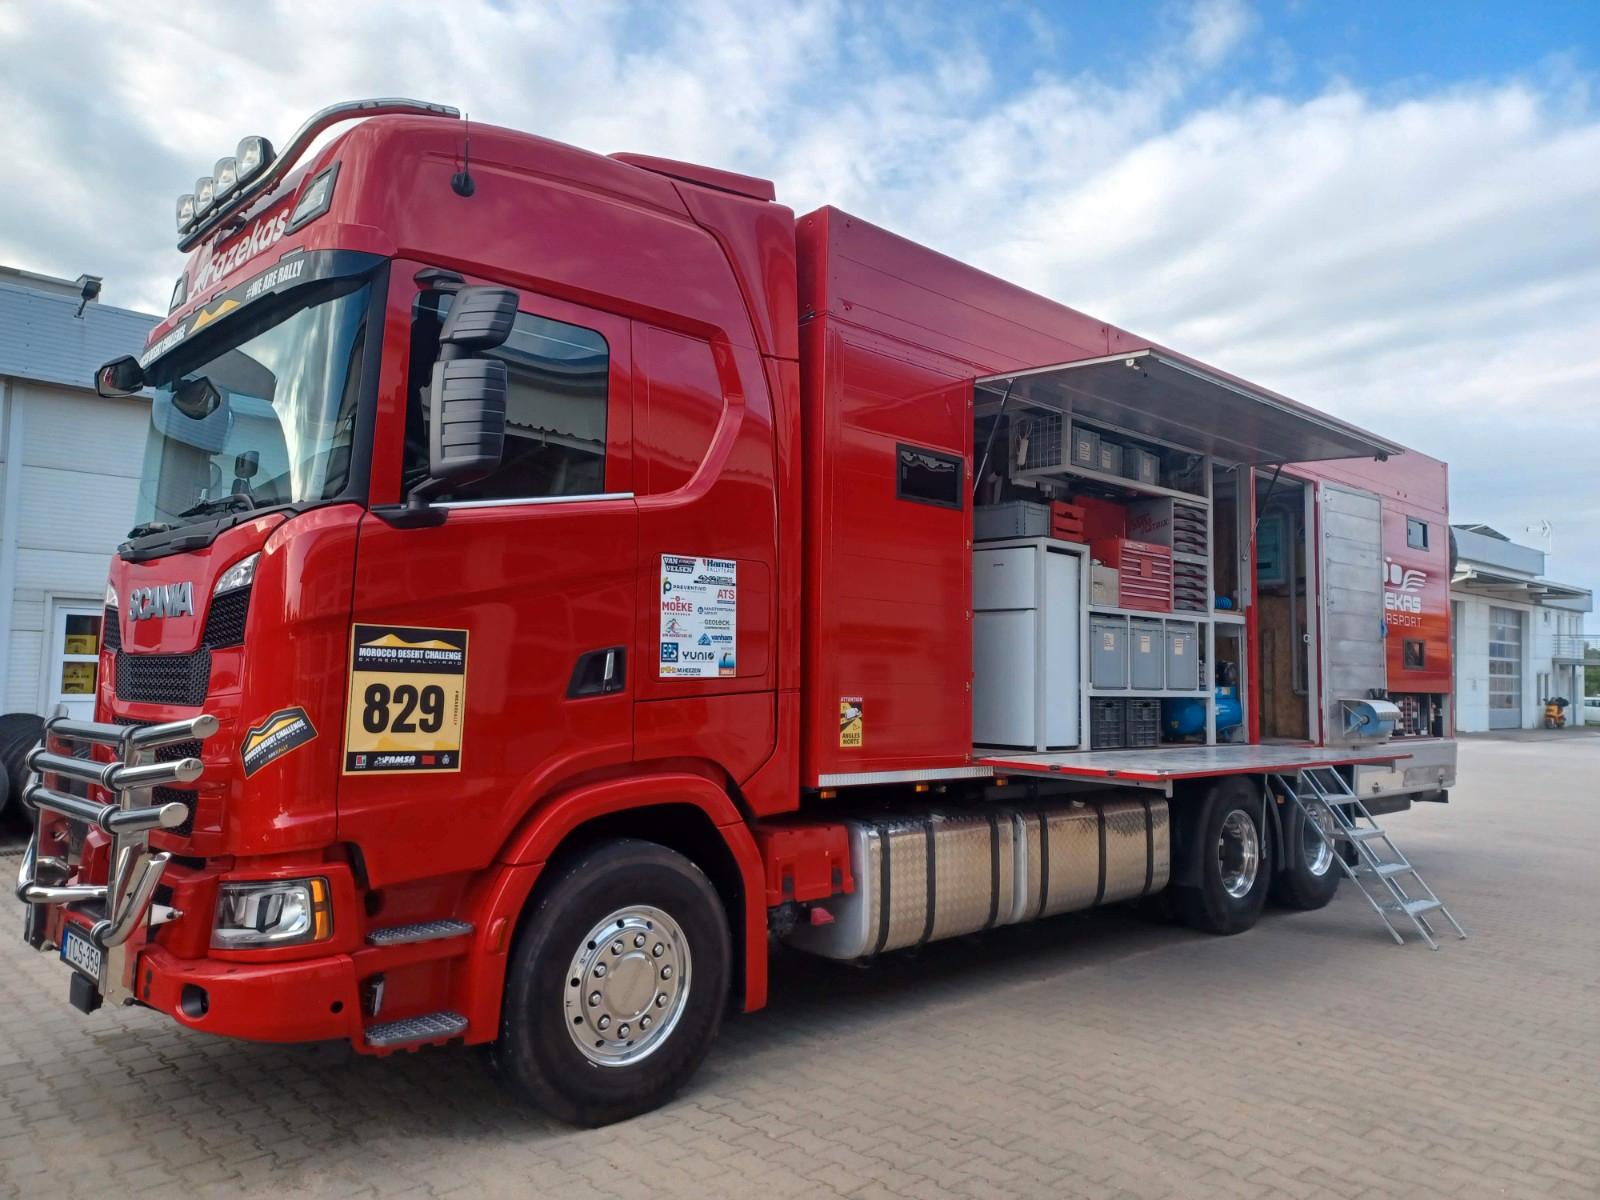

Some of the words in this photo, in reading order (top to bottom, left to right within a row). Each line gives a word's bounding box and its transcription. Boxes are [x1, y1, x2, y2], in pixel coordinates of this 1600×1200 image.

[262, 269, 278, 292] ARE
[277, 259, 304, 284] RALLY
[129, 582, 194, 621] SCANIA
[717, 589, 735, 600] ATS
[1385, 591, 1422, 614] EKAS
[662, 602, 693, 613] MOEKE
[1386, 613, 1422, 628] RSPORT
[359, 648, 397, 658] MOROCCO
[397, 650, 424, 659] DESERT
[424, 650, 462, 660] CHALLENGE
[362, 683, 445, 734] 829
[69, 935, 99, 976] TCS-359
